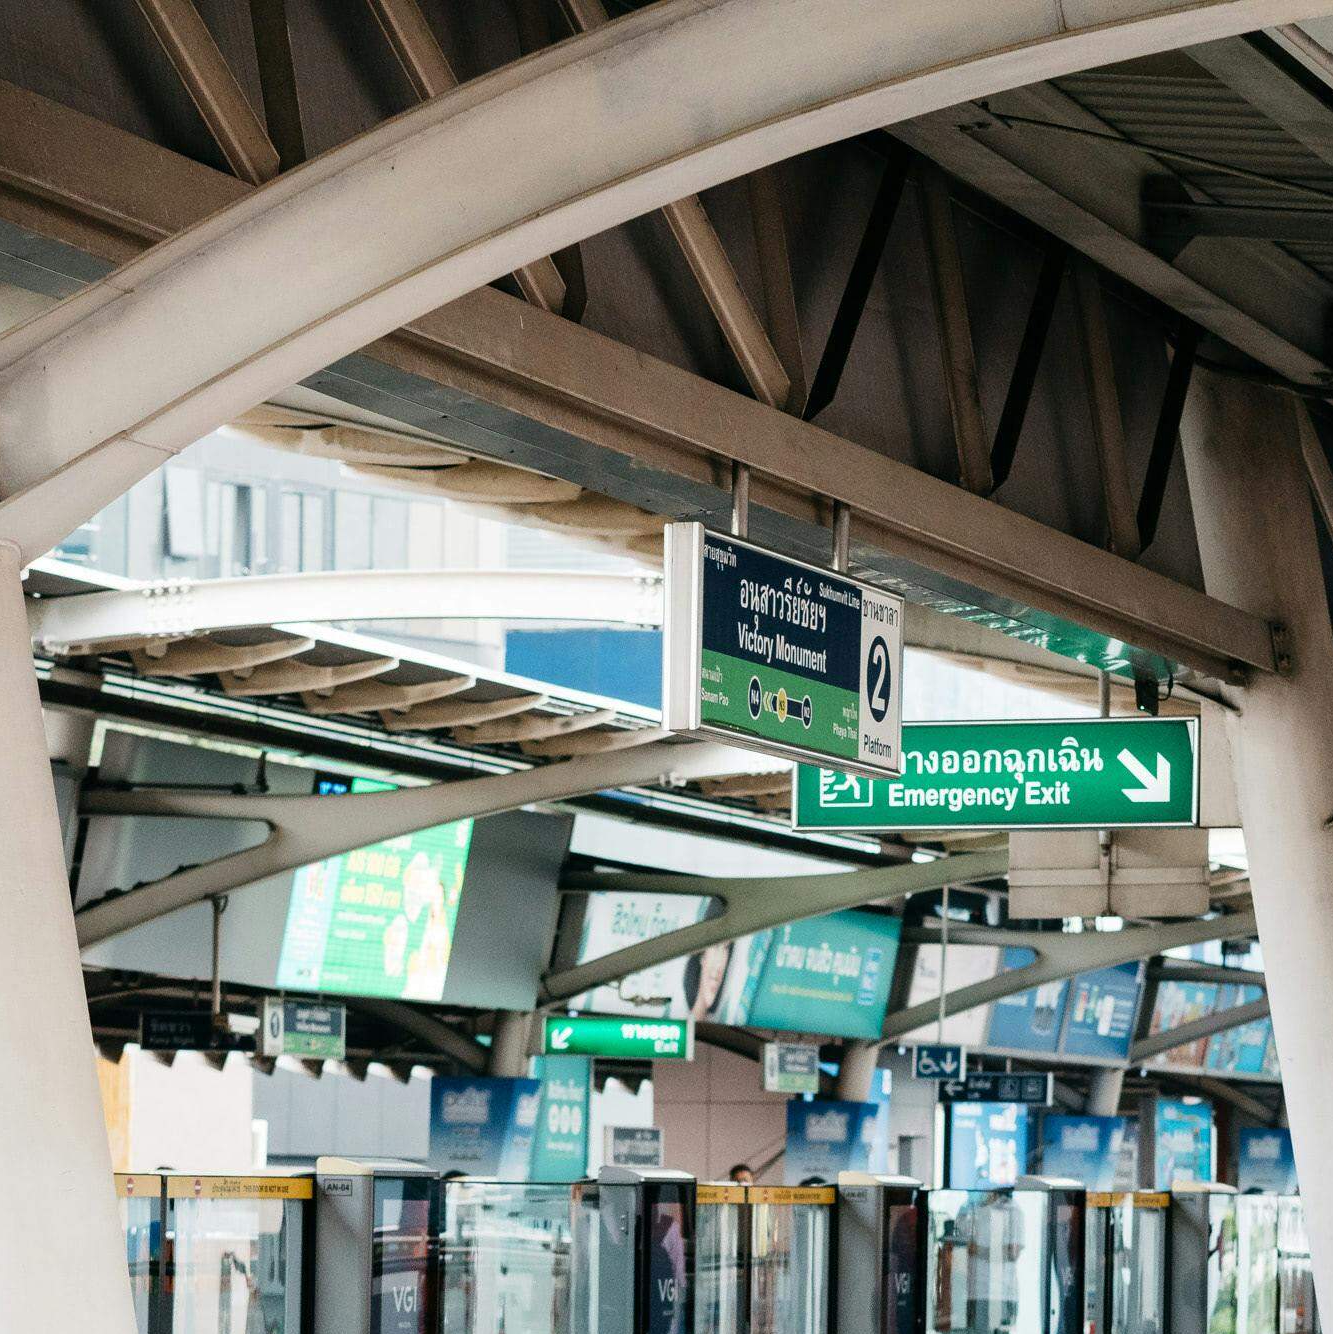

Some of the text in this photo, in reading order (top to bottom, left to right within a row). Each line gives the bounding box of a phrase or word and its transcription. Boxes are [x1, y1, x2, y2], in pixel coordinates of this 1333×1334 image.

[740, 577, 827, 633] อนุสาวรีย์ชัยฯ
[819, 582, 860, 610] Sukhumvit Line
[863, 599, 899, 627] ชานชาลา
[738, 621, 827, 674] Victory Monument
[871, 644, 886, 713] 2
[863, 735, 892, 759] Platform
[888, 781, 1070, 811] Emergency Exit
[393, 1285, 417, 1313] VGI
